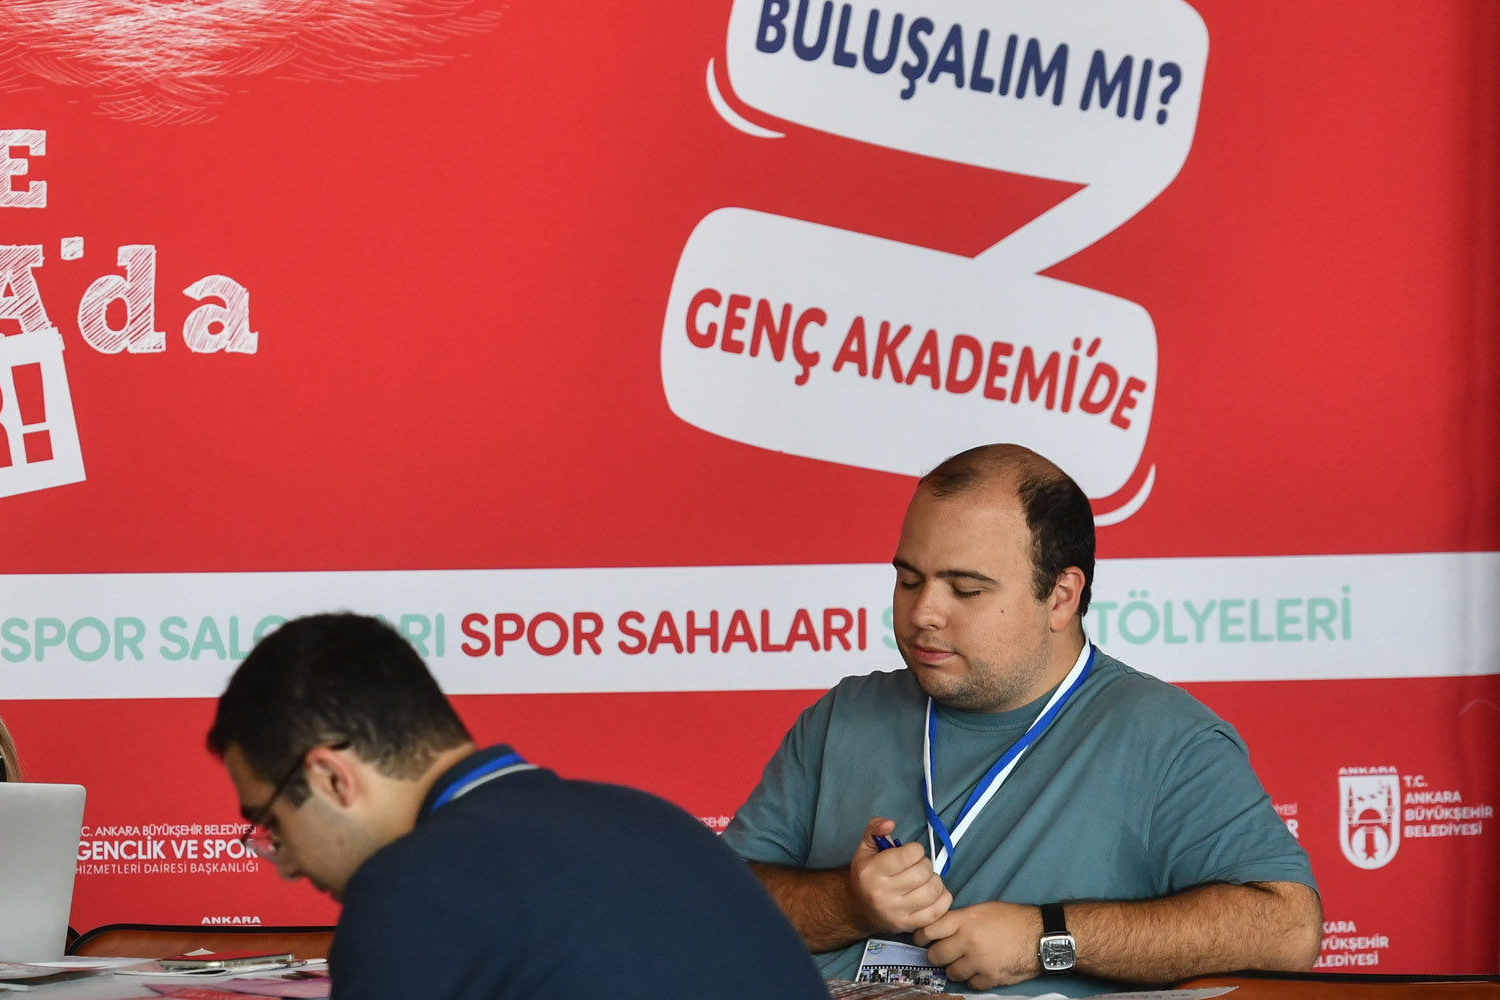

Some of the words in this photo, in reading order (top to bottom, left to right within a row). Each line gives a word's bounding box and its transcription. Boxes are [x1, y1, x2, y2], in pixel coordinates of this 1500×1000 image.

[755, 0, 1068, 106] BULUŞALIM
[1080, 49, 1182, 125] MI?
[685, 287, 826, 386] GENÇ
[833, 316, 1146, 431] AKADEMİ'DE
[0, 615, 146, 662] SPOR
[461, 612, 604, 657] SPOR
[617, 607, 867, 655] SAHALARI
[1082, 585, 1352, 645] TÖLYELERİ
[1404, 775, 1428, 787] T.C.
[1404, 791, 1462, 803] ANKARA
[1404, 805, 1493, 822] BÜYÜKŞEHİR
[95, 826, 140, 837] ANKARA
[1404, 821, 1482, 837] BELEDİYESİ
[77, 835, 167, 861] GENÇLİK
[171, 839, 199, 860] VE
[144, 861, 187, 874] DAİRESİ
[191, 860, 259, 875] BAŞKANLIĞI
[201, 916, 261, 924] ANKARA
